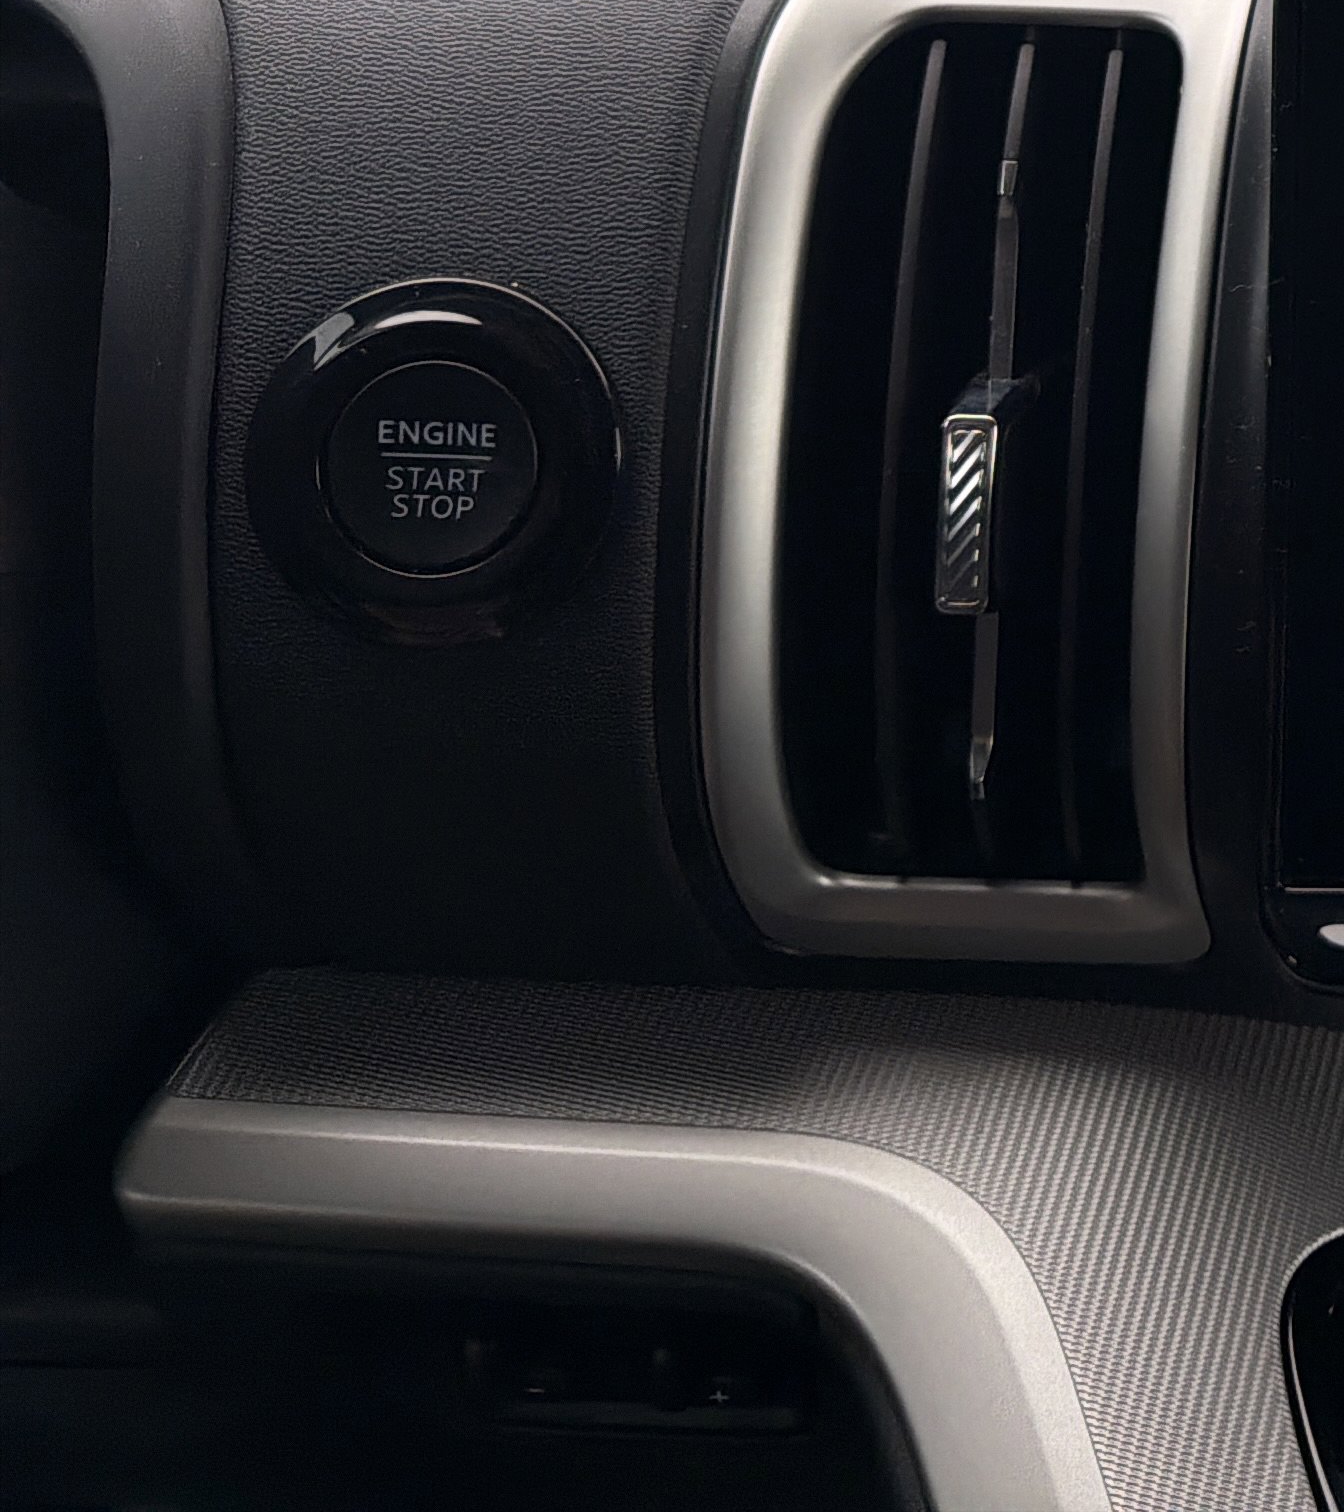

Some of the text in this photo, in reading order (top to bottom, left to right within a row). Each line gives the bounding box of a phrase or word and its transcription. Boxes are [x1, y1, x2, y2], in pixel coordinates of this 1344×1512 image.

[377, 419, 498, 449] ENGINE
[385, 465, 486, 493] START
[390, 493, 475, 521] STOP
